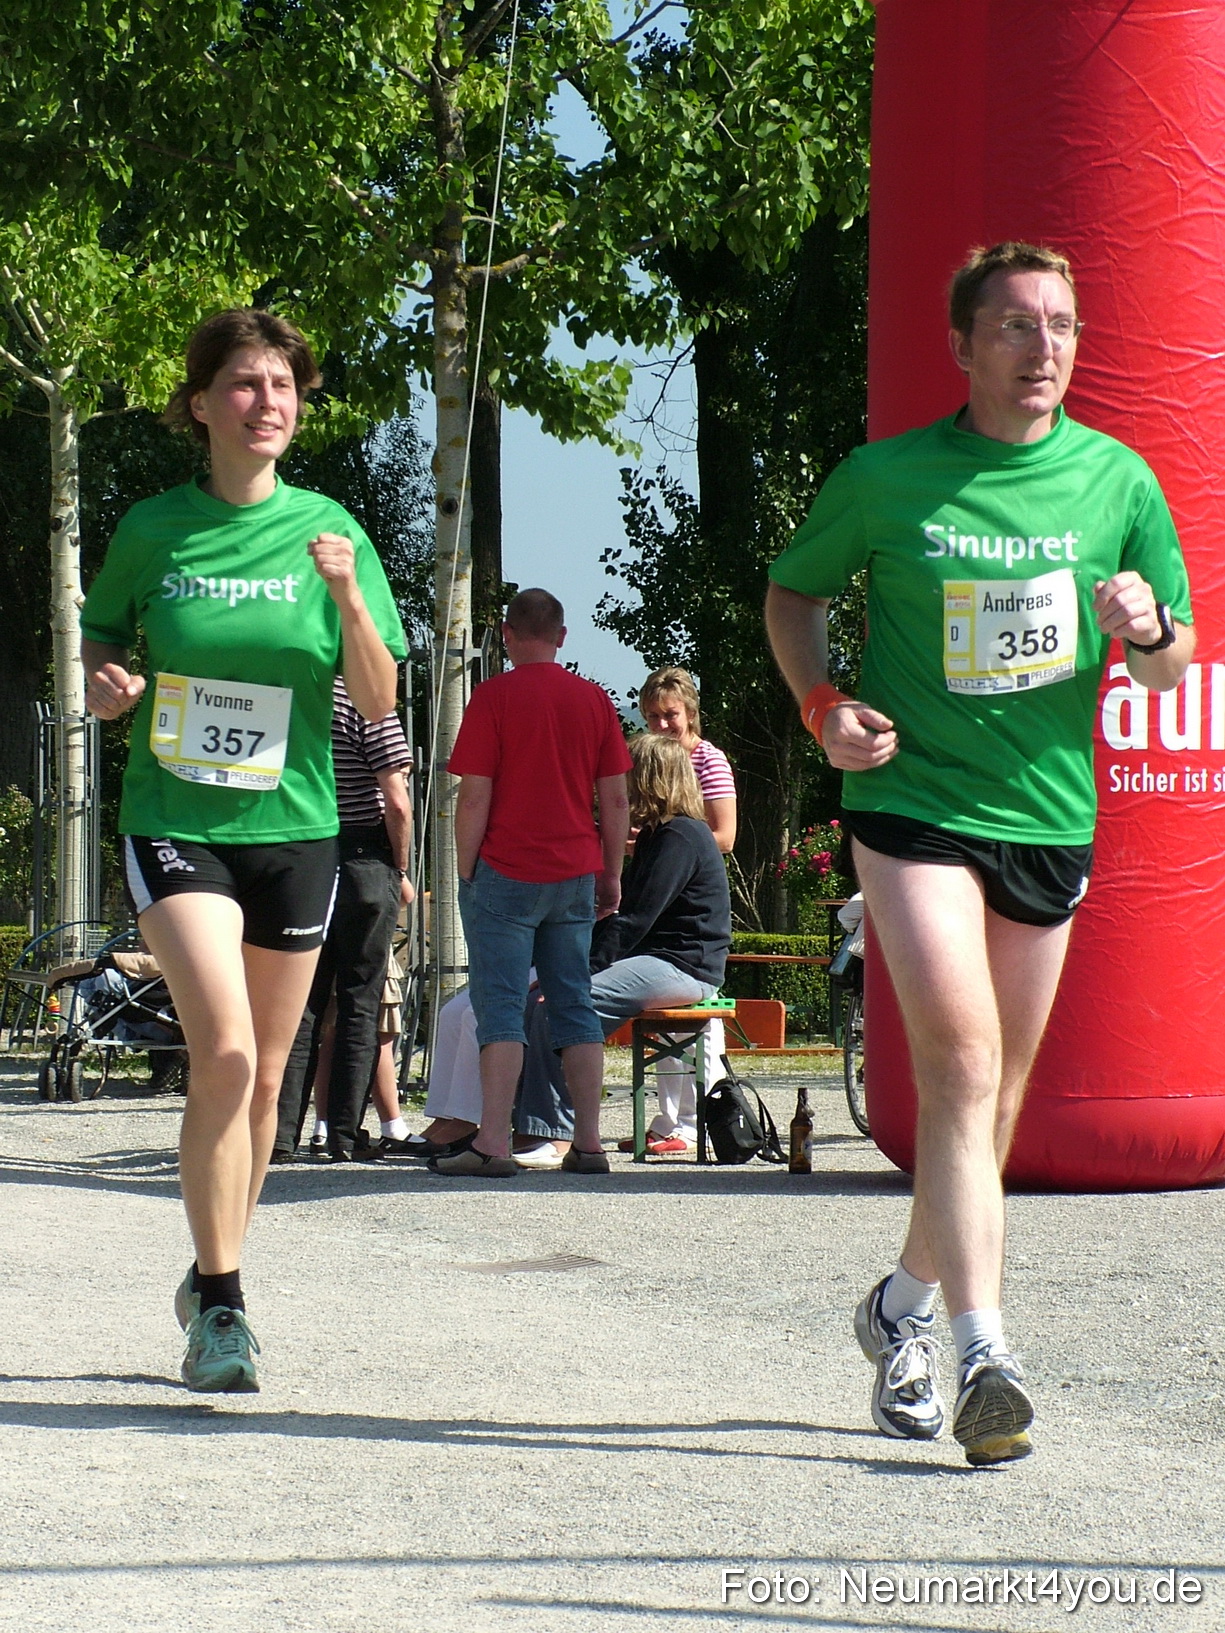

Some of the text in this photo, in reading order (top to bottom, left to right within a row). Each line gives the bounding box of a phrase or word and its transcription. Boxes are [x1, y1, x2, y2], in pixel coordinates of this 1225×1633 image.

[924, 524, 1079, 569] Sinupret
[161, 573, 298, 607] Sinupret
[983, 592, 1053, 612] Andreas
[951, 626, 959, 641] D
[998, 625, 1059, 661] 358
[194, 686, 253, 711] Yvonne
[159, 713, 168, 728] D
[202, 725, 265, 758] 357
[1109, 762, 1178, 793] Sicher
[1184, 766, 1208, 793] ist
